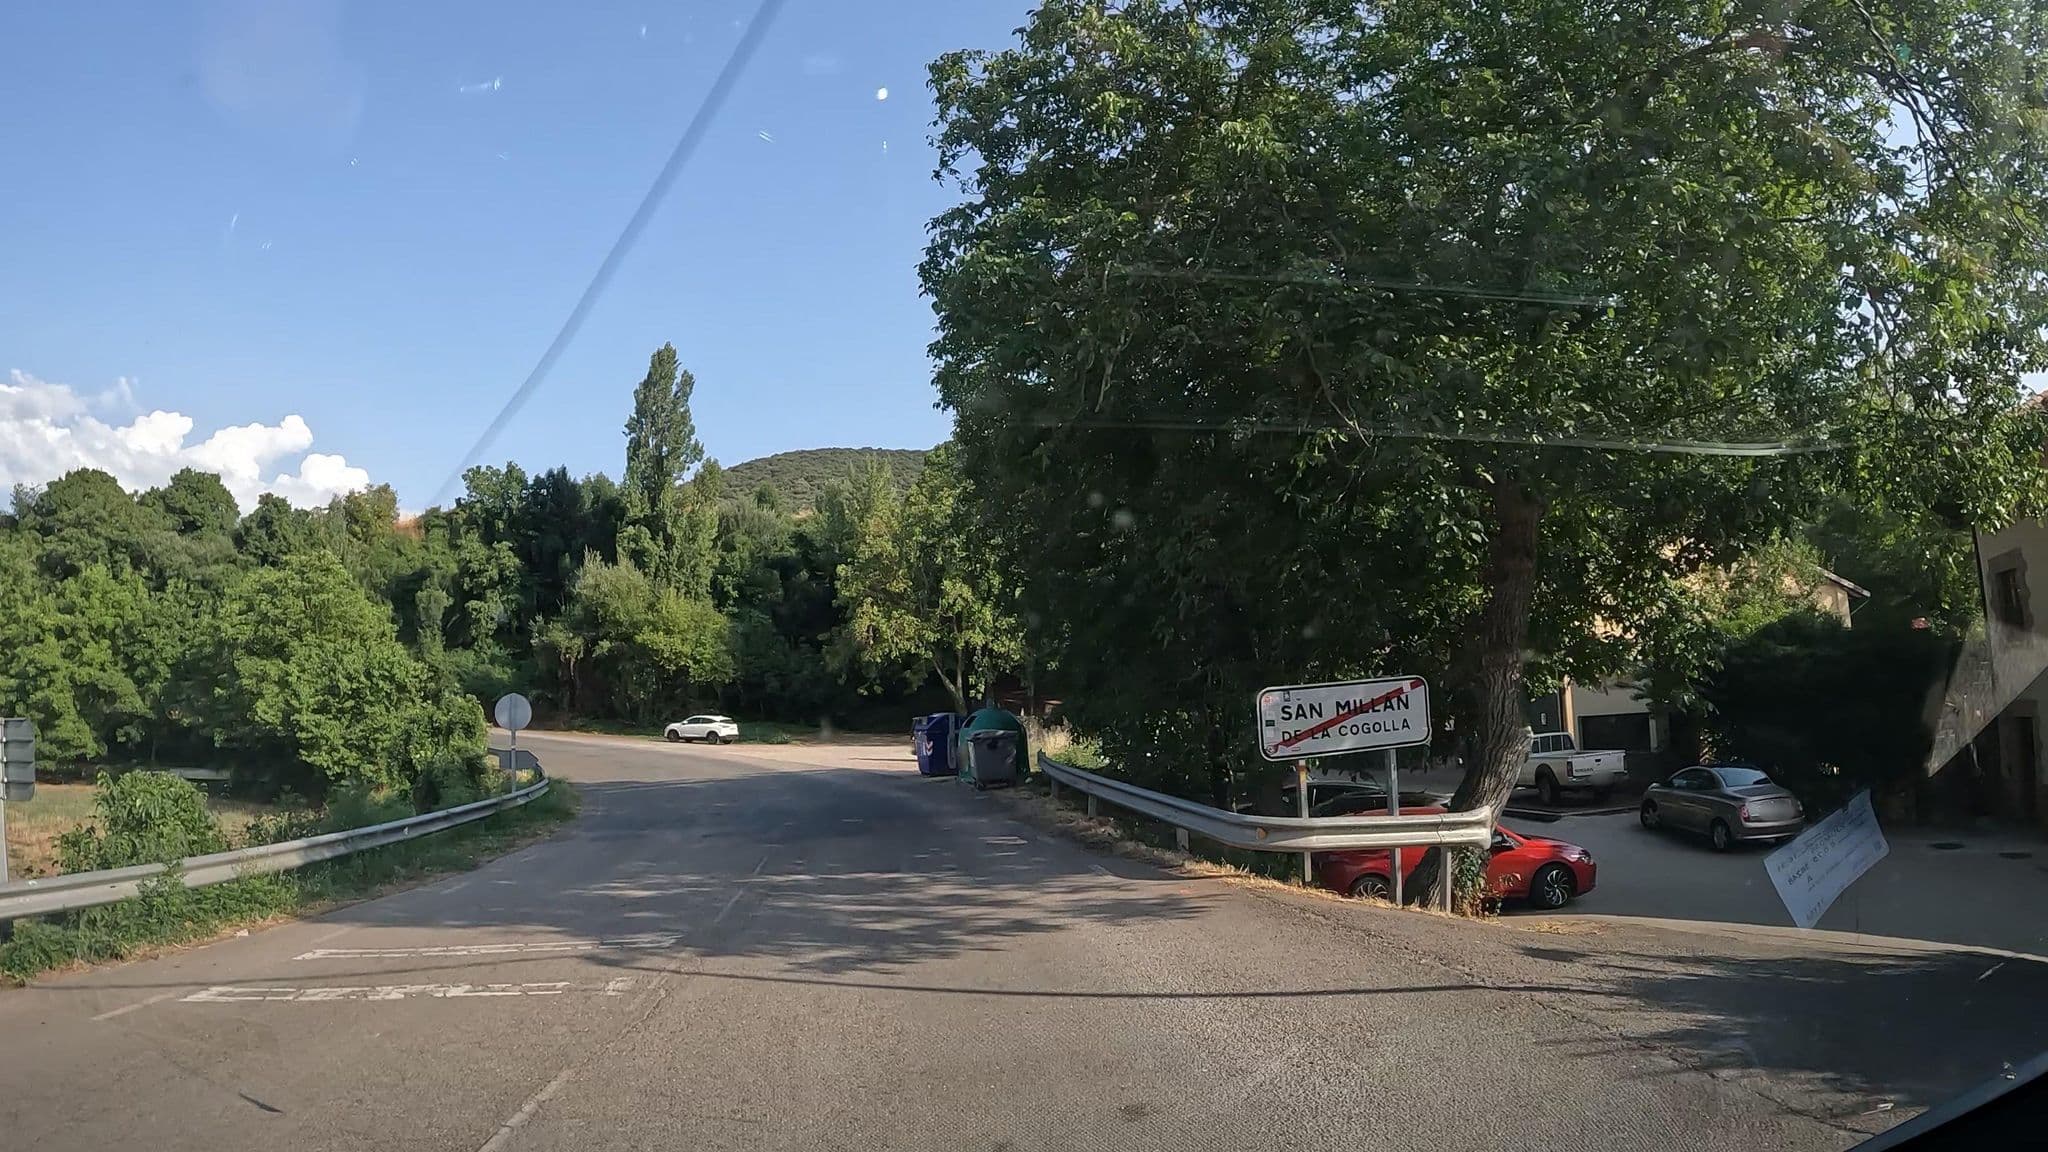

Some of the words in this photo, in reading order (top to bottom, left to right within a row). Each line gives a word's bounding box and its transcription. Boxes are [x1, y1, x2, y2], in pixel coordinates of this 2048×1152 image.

[1280, 702, 1323, 721] SAN
[1281, 729, 1302, 742] DE
[1311, 727, 1331, 740] LA
[1338, 718, 1411, 737] COGOLLA
